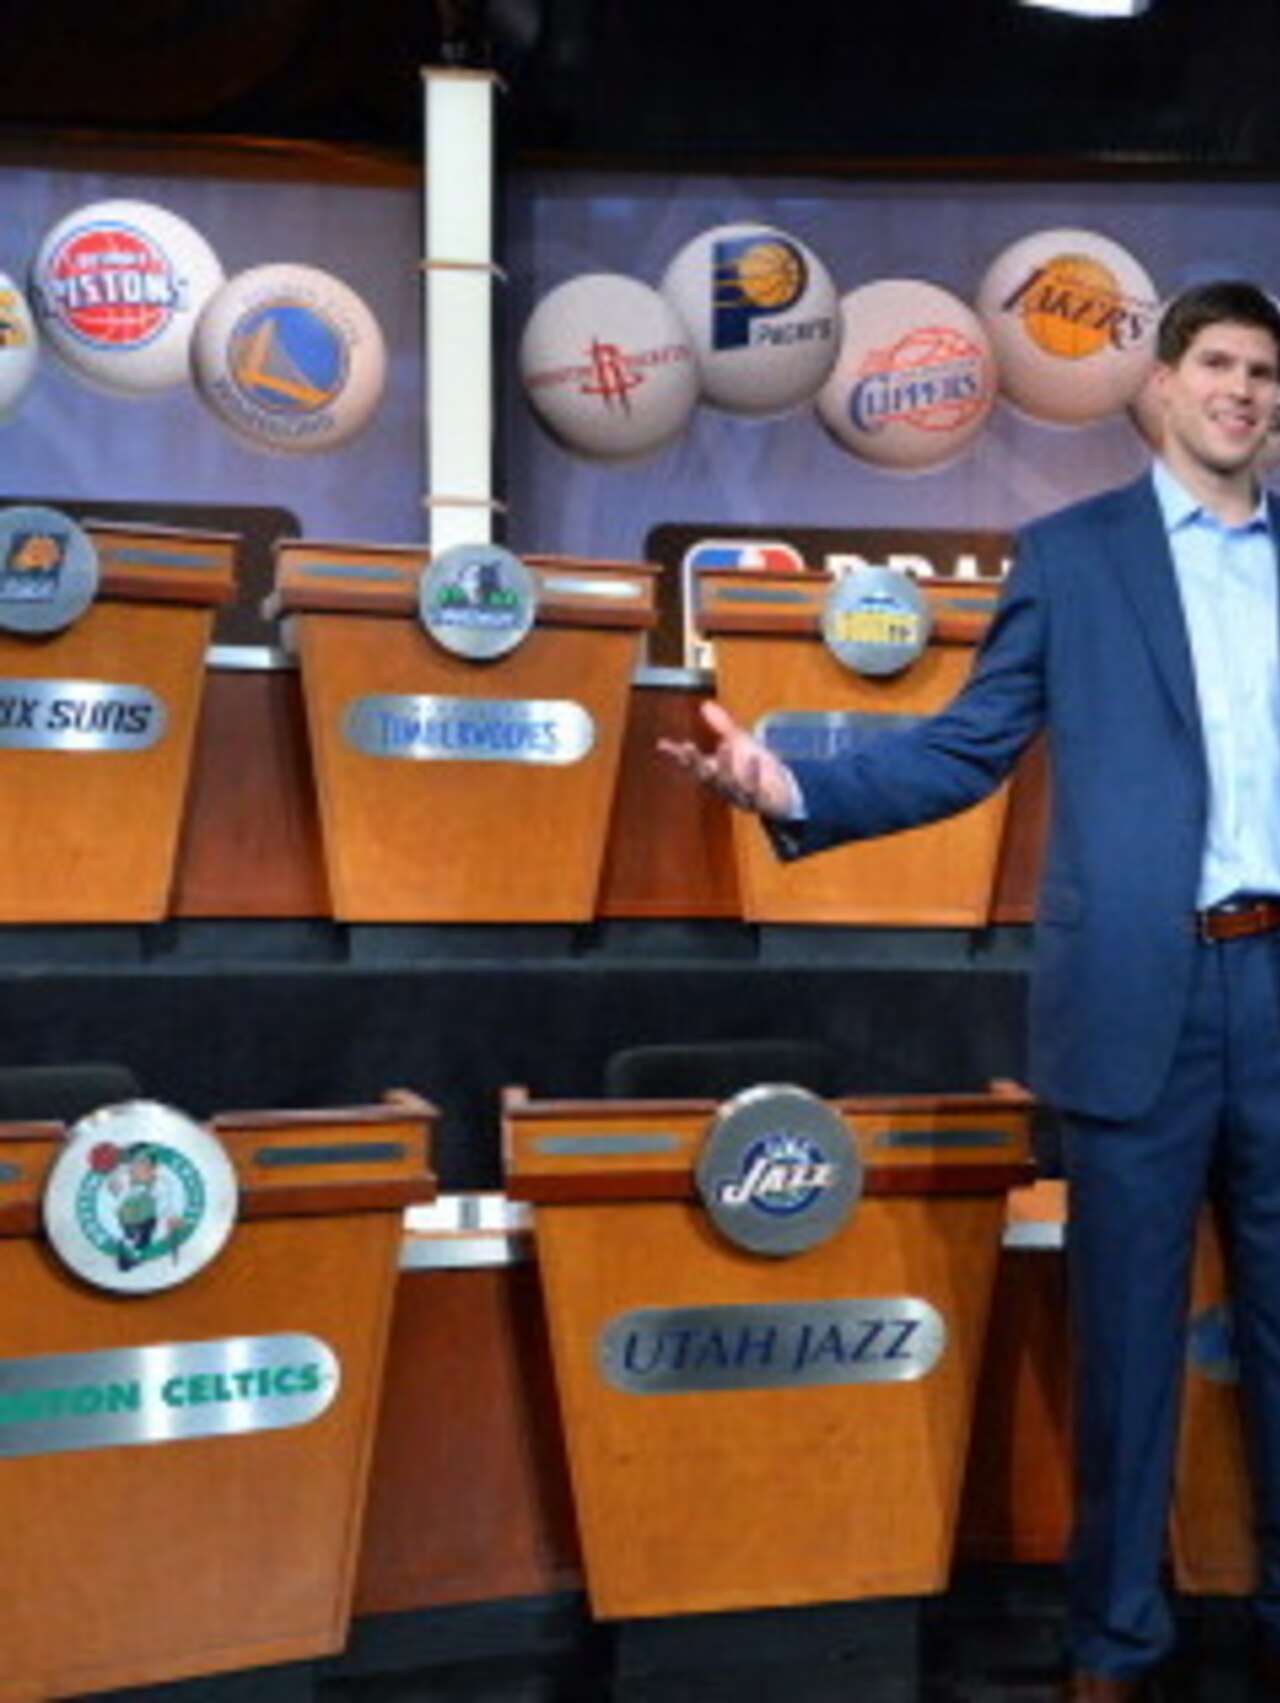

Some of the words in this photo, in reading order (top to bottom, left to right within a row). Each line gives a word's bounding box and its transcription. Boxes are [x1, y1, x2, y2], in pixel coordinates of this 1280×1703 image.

[623, 1325, 778, 1375] UTAH
[793, 1318, 922, 1374] JAZZ
[161, 1363, 322, 1408] CELTICS
